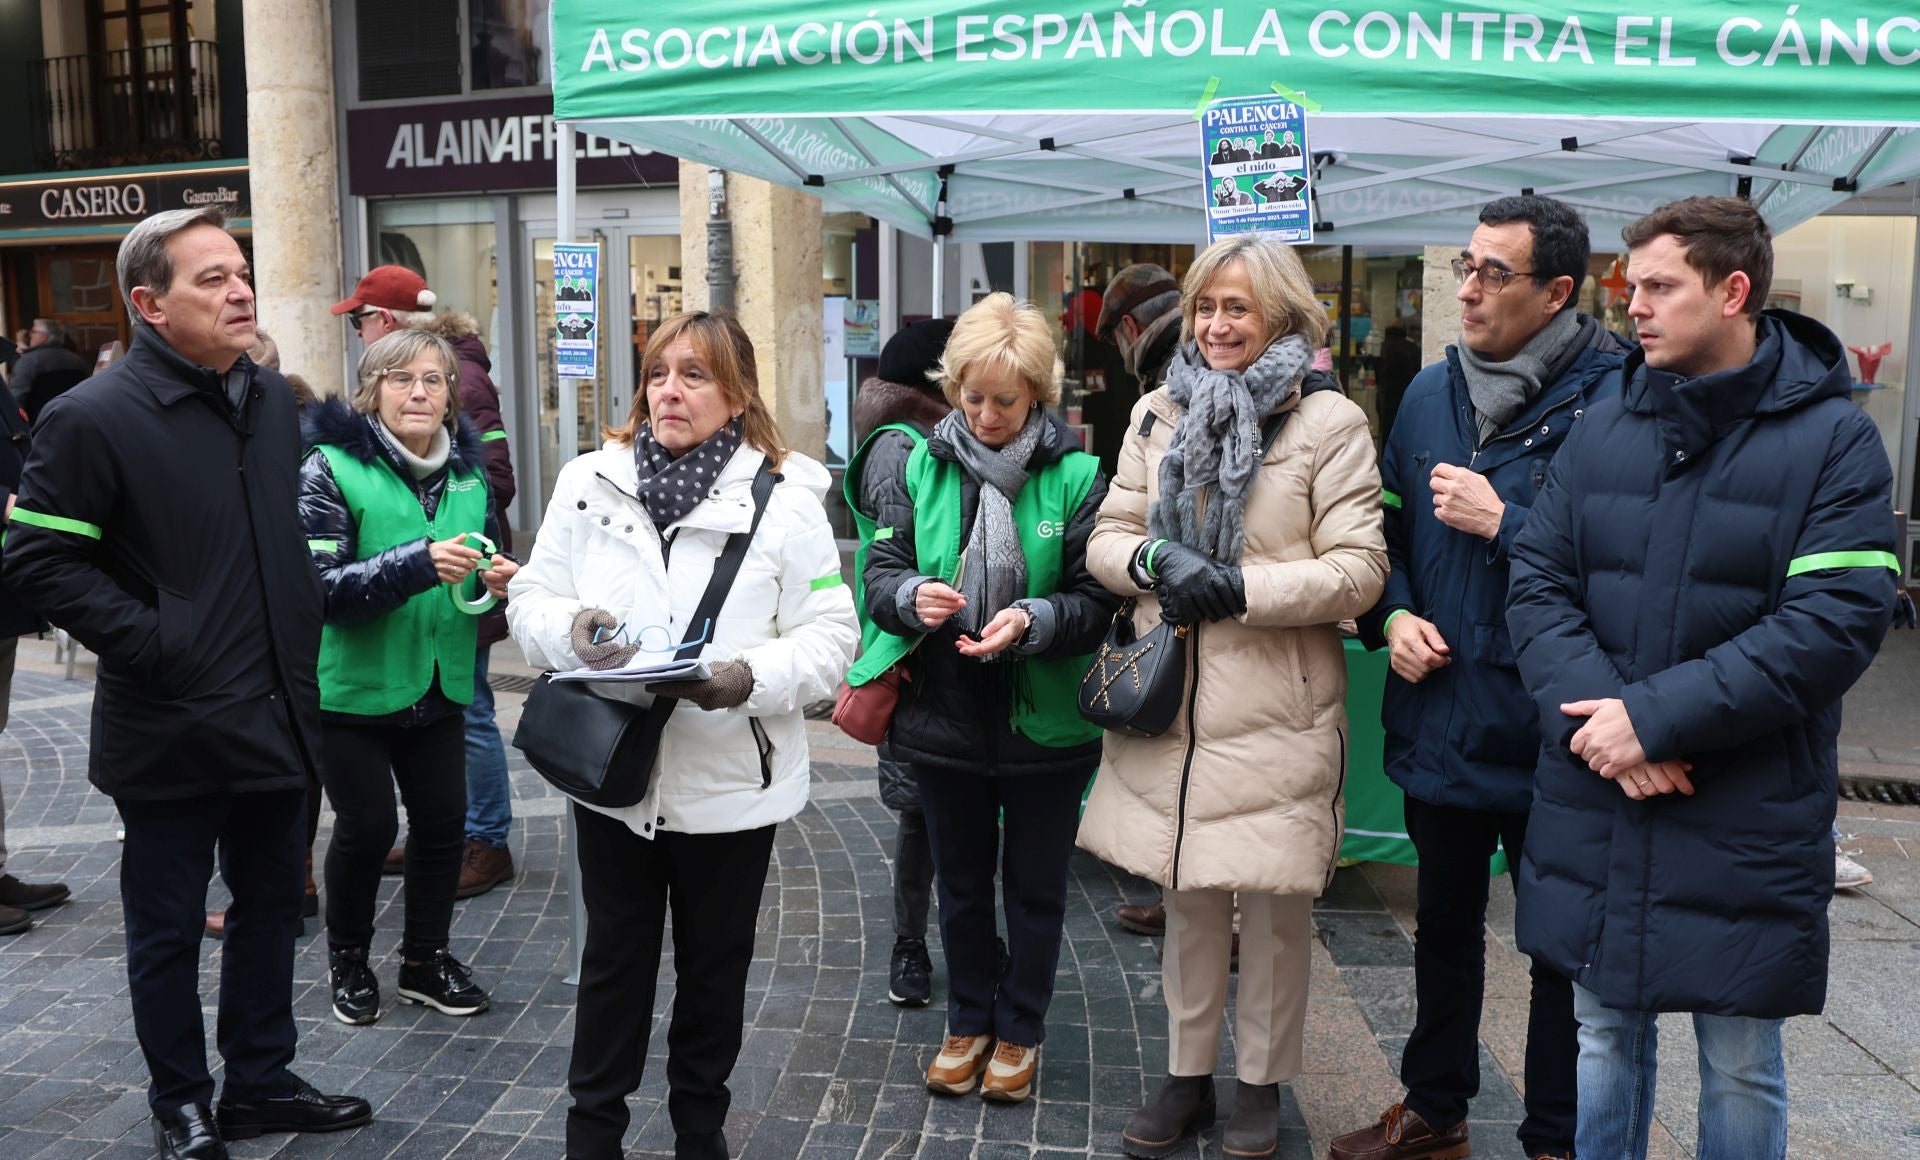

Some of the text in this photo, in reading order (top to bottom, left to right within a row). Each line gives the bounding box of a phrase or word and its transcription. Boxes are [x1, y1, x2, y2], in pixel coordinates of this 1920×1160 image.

[580, 9, 934, 72] ASOCIACIÓN
[956, 0, 1291, 62] ESPAÑOLA
[1308, 10, 1595, 65] CONTRA
[1614, 16, 1697, 66] EL
[1207, 103, 1299, 127] PALENCIA
[1220, 125, 1248, 135] CONTRA
[1250, 124, 1259, 132] EL
[1250, 162, 1276, 172] nido
[182, 186, 239, 204] GastroBar
